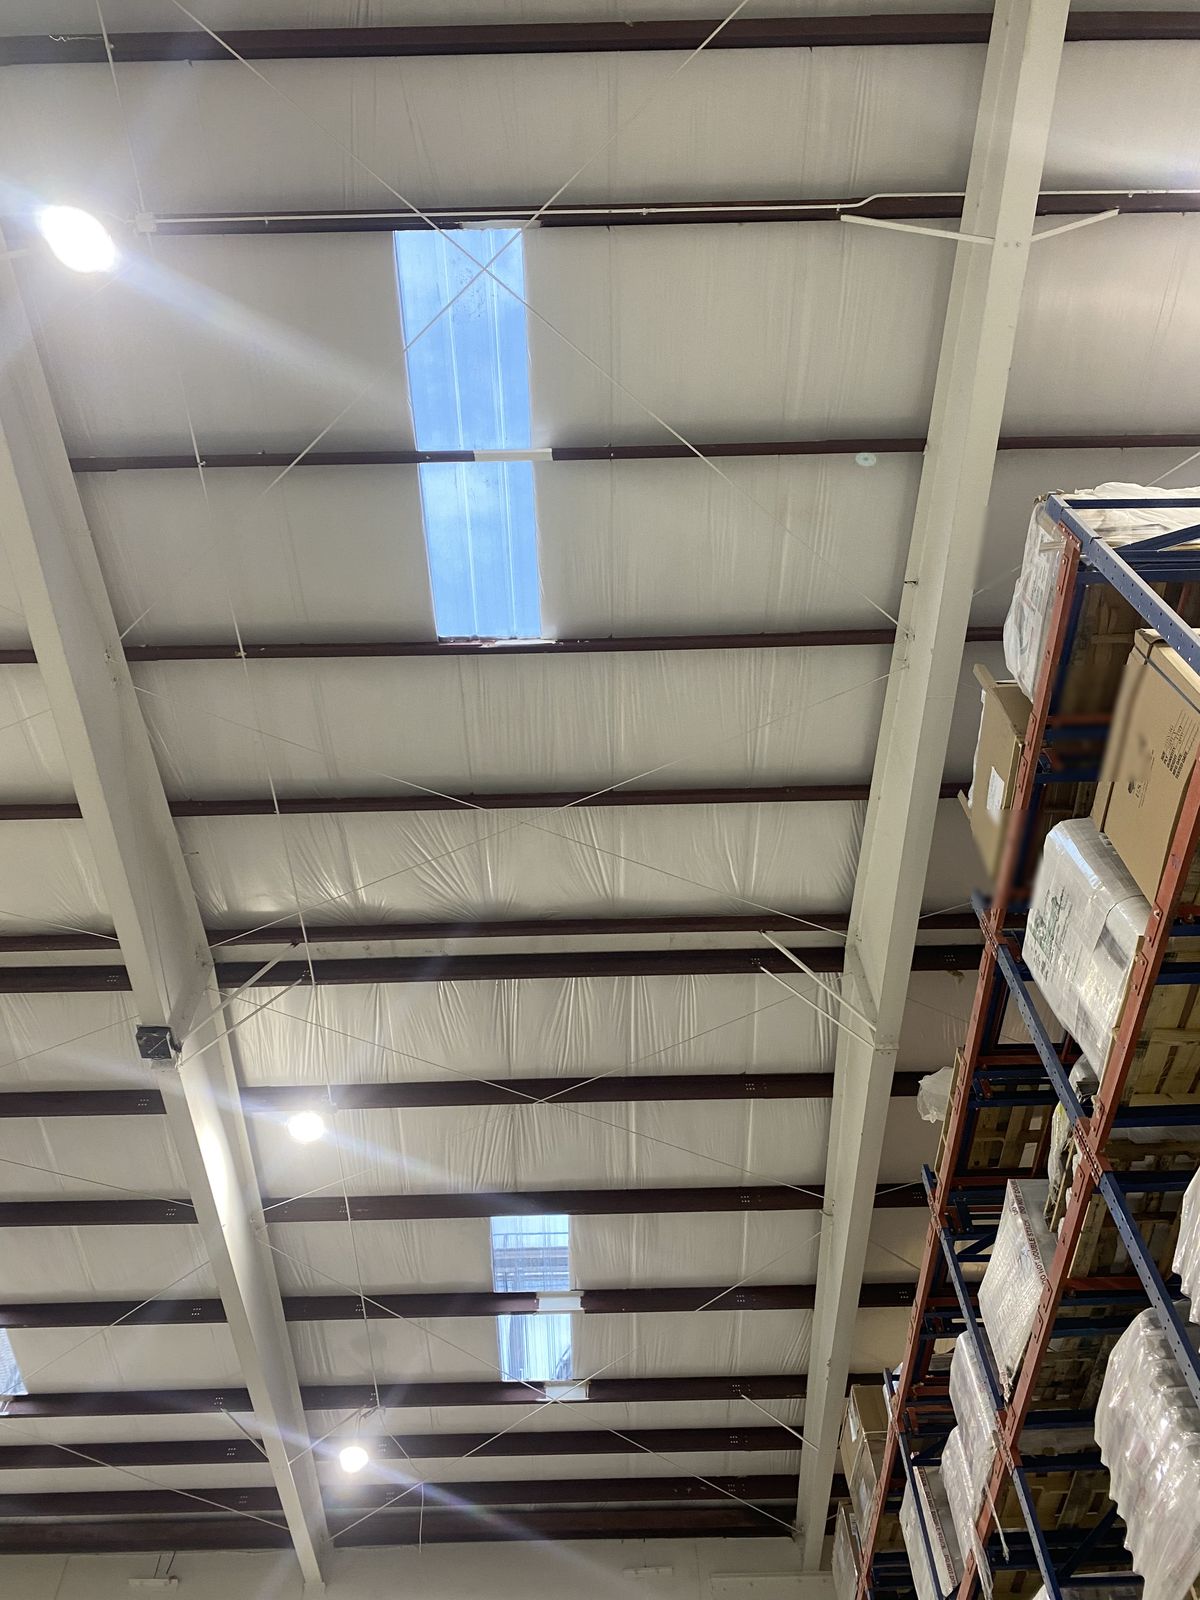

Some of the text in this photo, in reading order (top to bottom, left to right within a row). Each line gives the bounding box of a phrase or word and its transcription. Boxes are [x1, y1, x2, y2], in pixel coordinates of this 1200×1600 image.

[1016, 1194, 1024, 1205] NOT
[1019, 1206, 1026, 1214] DO
[1024, 1219, 1033, 1236] STACK
[1029, 1237, 1040, 1260] DOUBLE
[1035, 1262, 1043, 1274] NOT
